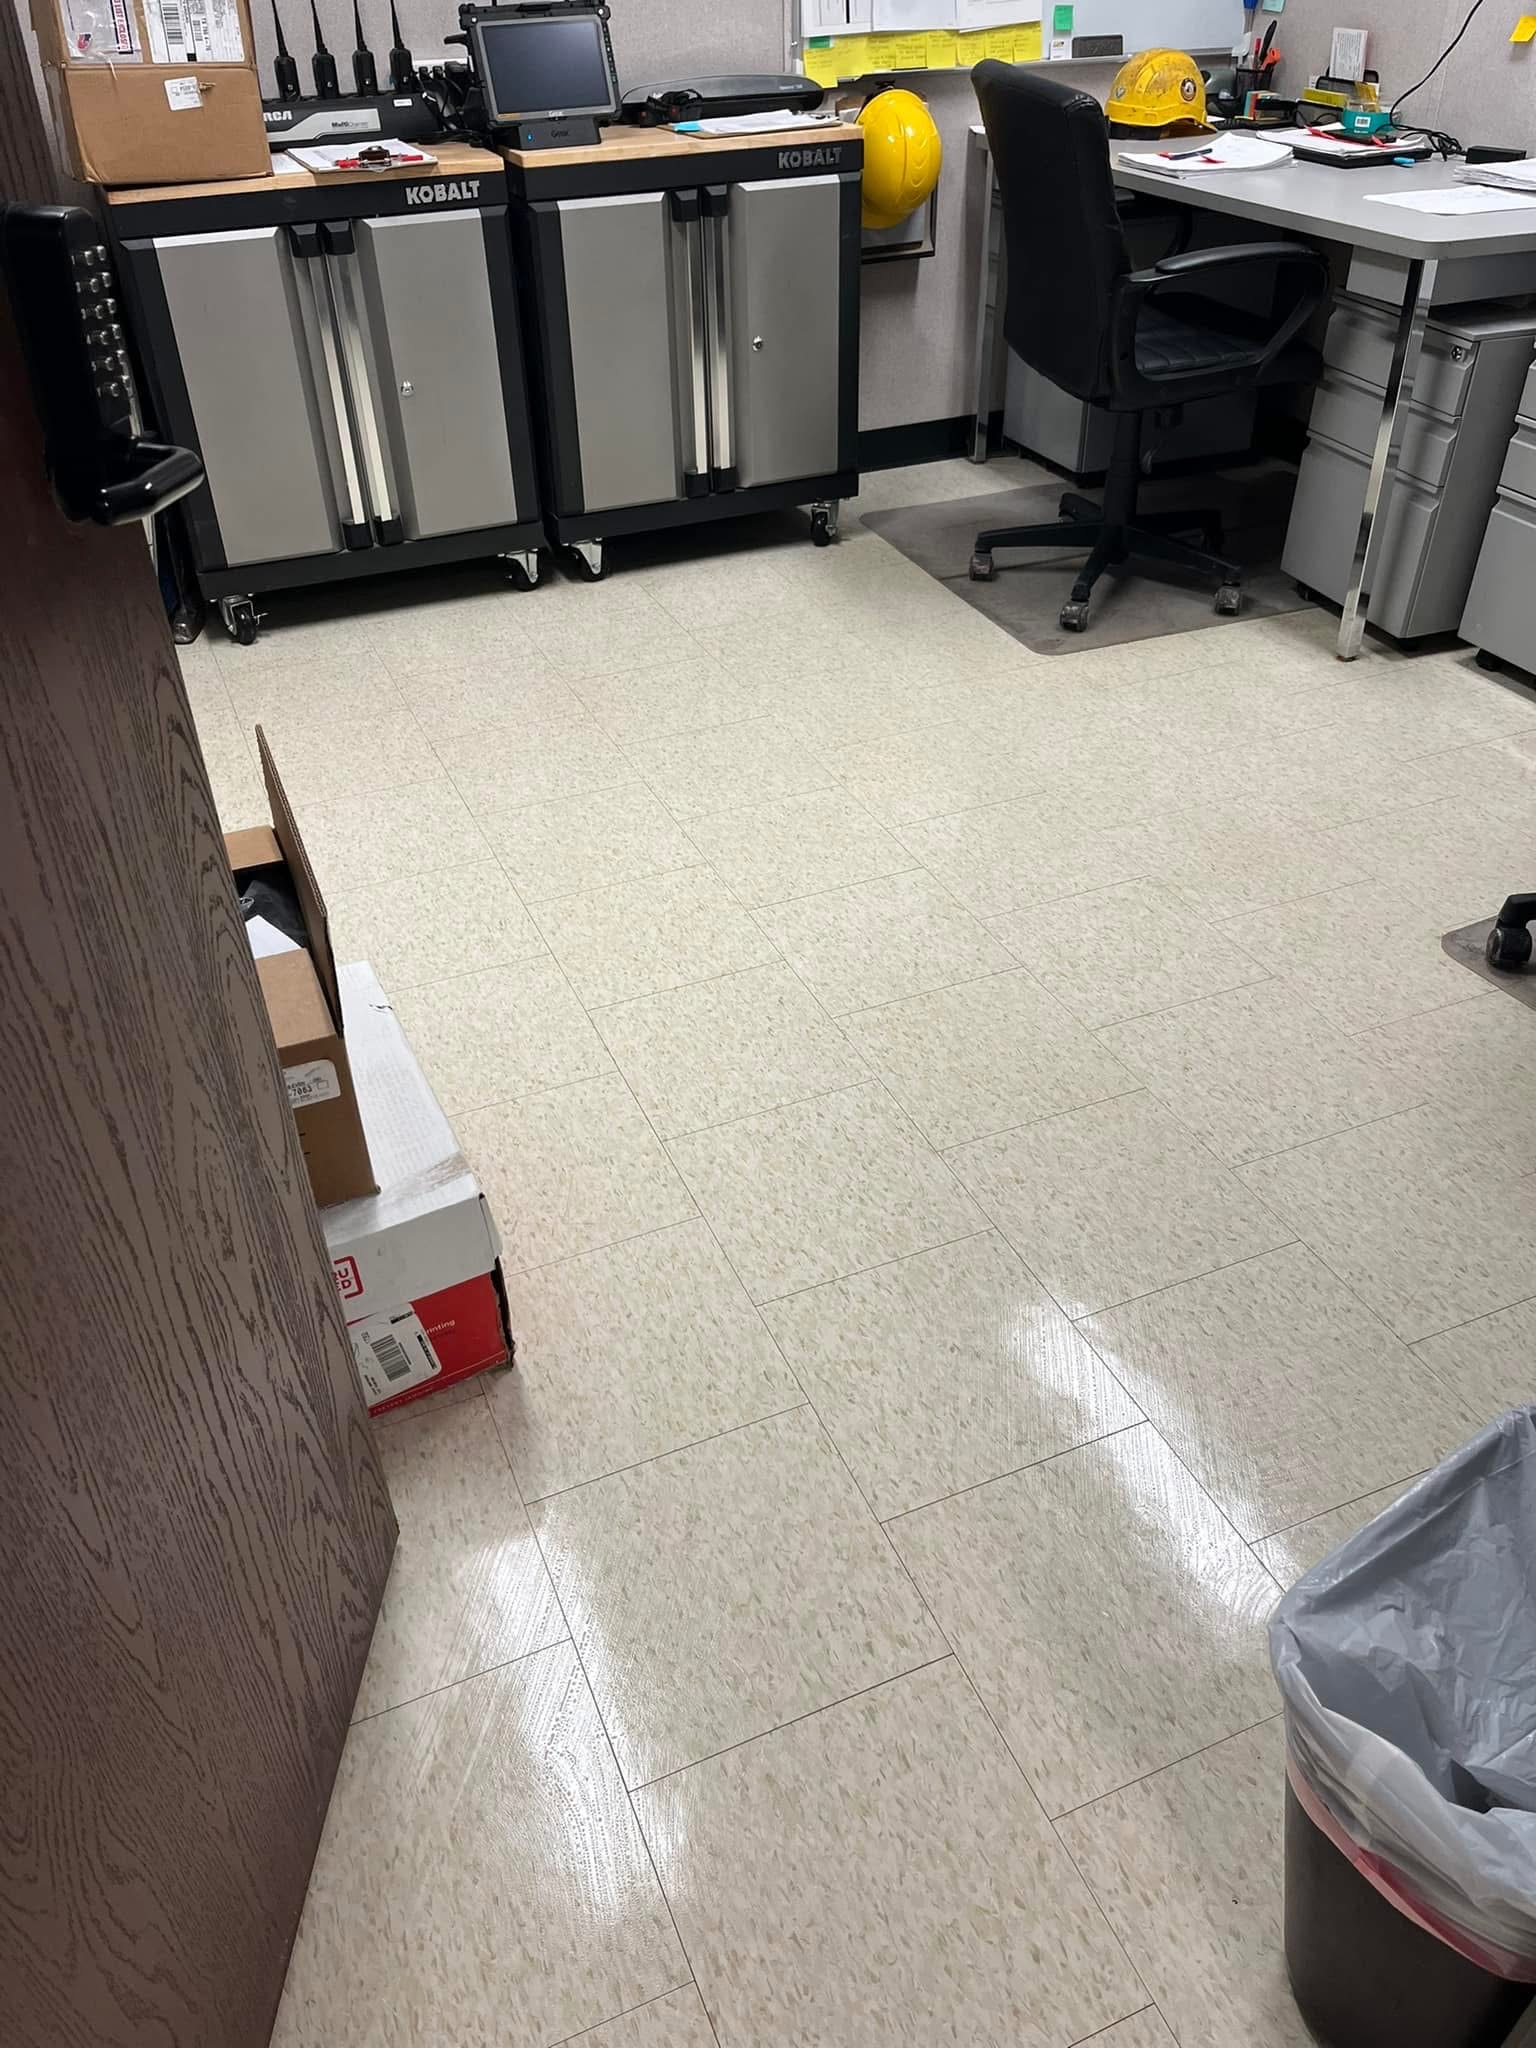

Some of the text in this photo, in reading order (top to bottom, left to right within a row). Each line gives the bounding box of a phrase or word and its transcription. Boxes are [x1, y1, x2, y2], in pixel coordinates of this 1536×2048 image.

[263, 110, 292, 122] RCA
[778, 147, 842, 169] KOBALT
[405, 180, 480, 205] KOBALT
[426, 1320, 456, 1335] rinting
